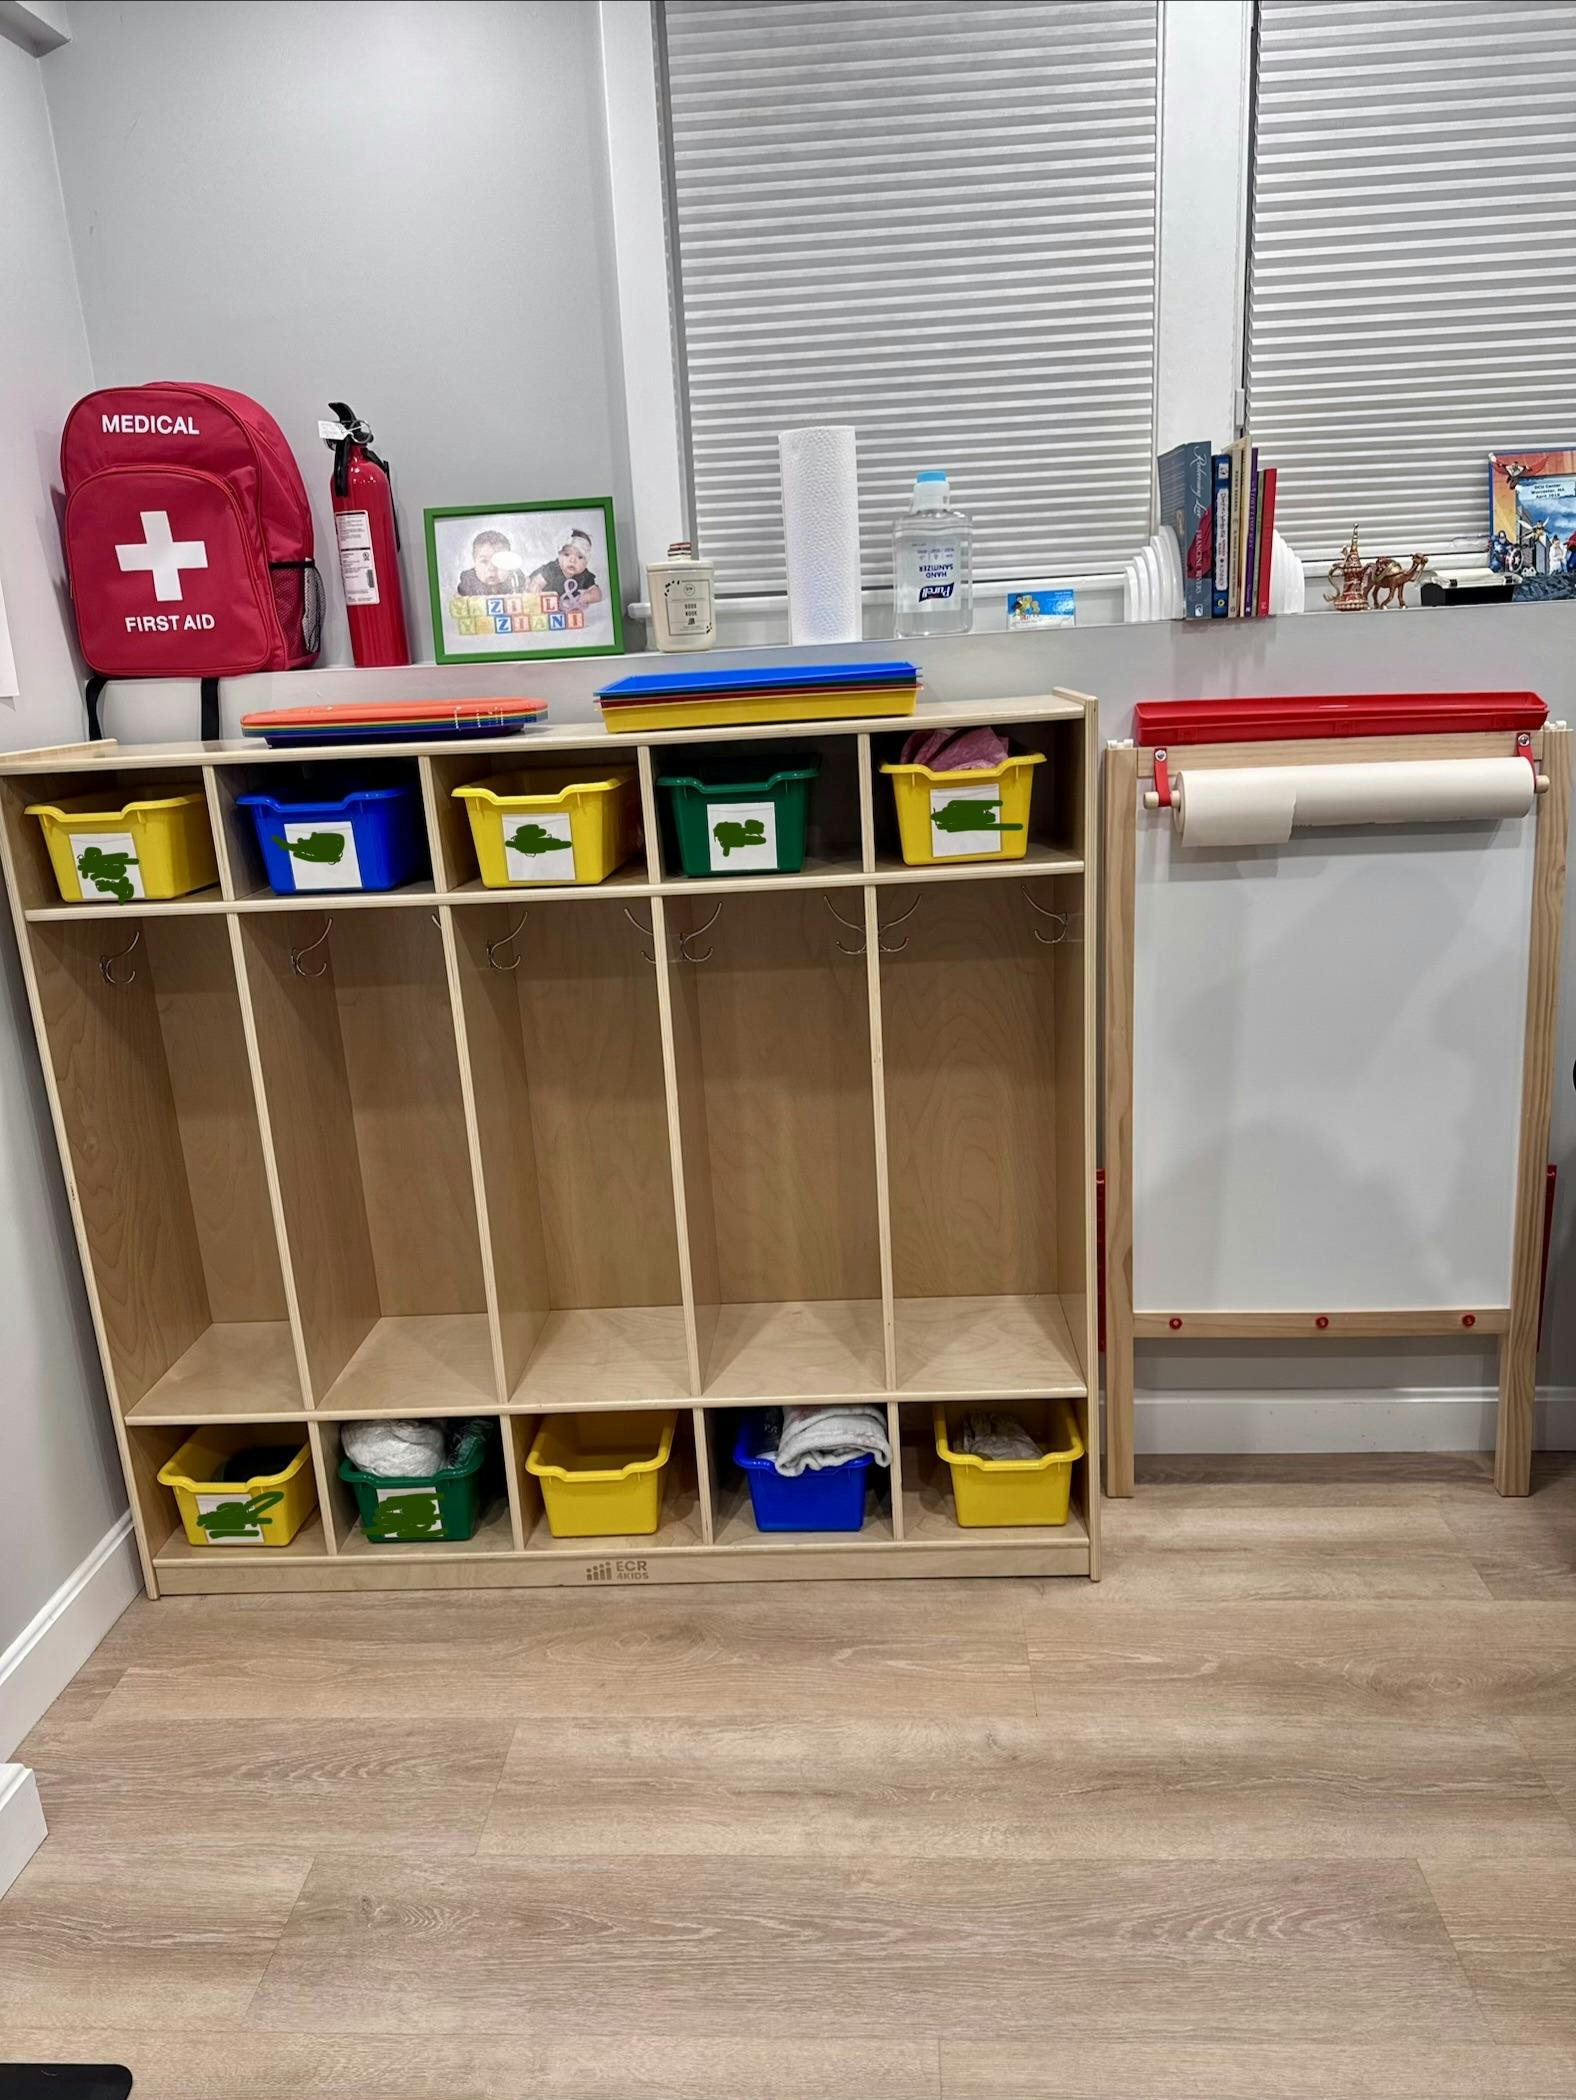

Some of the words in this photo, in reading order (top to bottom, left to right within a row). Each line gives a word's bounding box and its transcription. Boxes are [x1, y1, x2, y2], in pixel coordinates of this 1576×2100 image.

[101, 414, 200, 435] MEDICAL
[1193, 498, 1209, 519] Love
[919, 564, 953, 572] SANITIZER
[921, 586, 951, 598] Purell
[125, 615, 180, 633] FIRST
[183, 614, 215, 631] AID
[616, 1560, 648, 1572] ECR
[616, 1572, 649, 1580] 4KIDS
